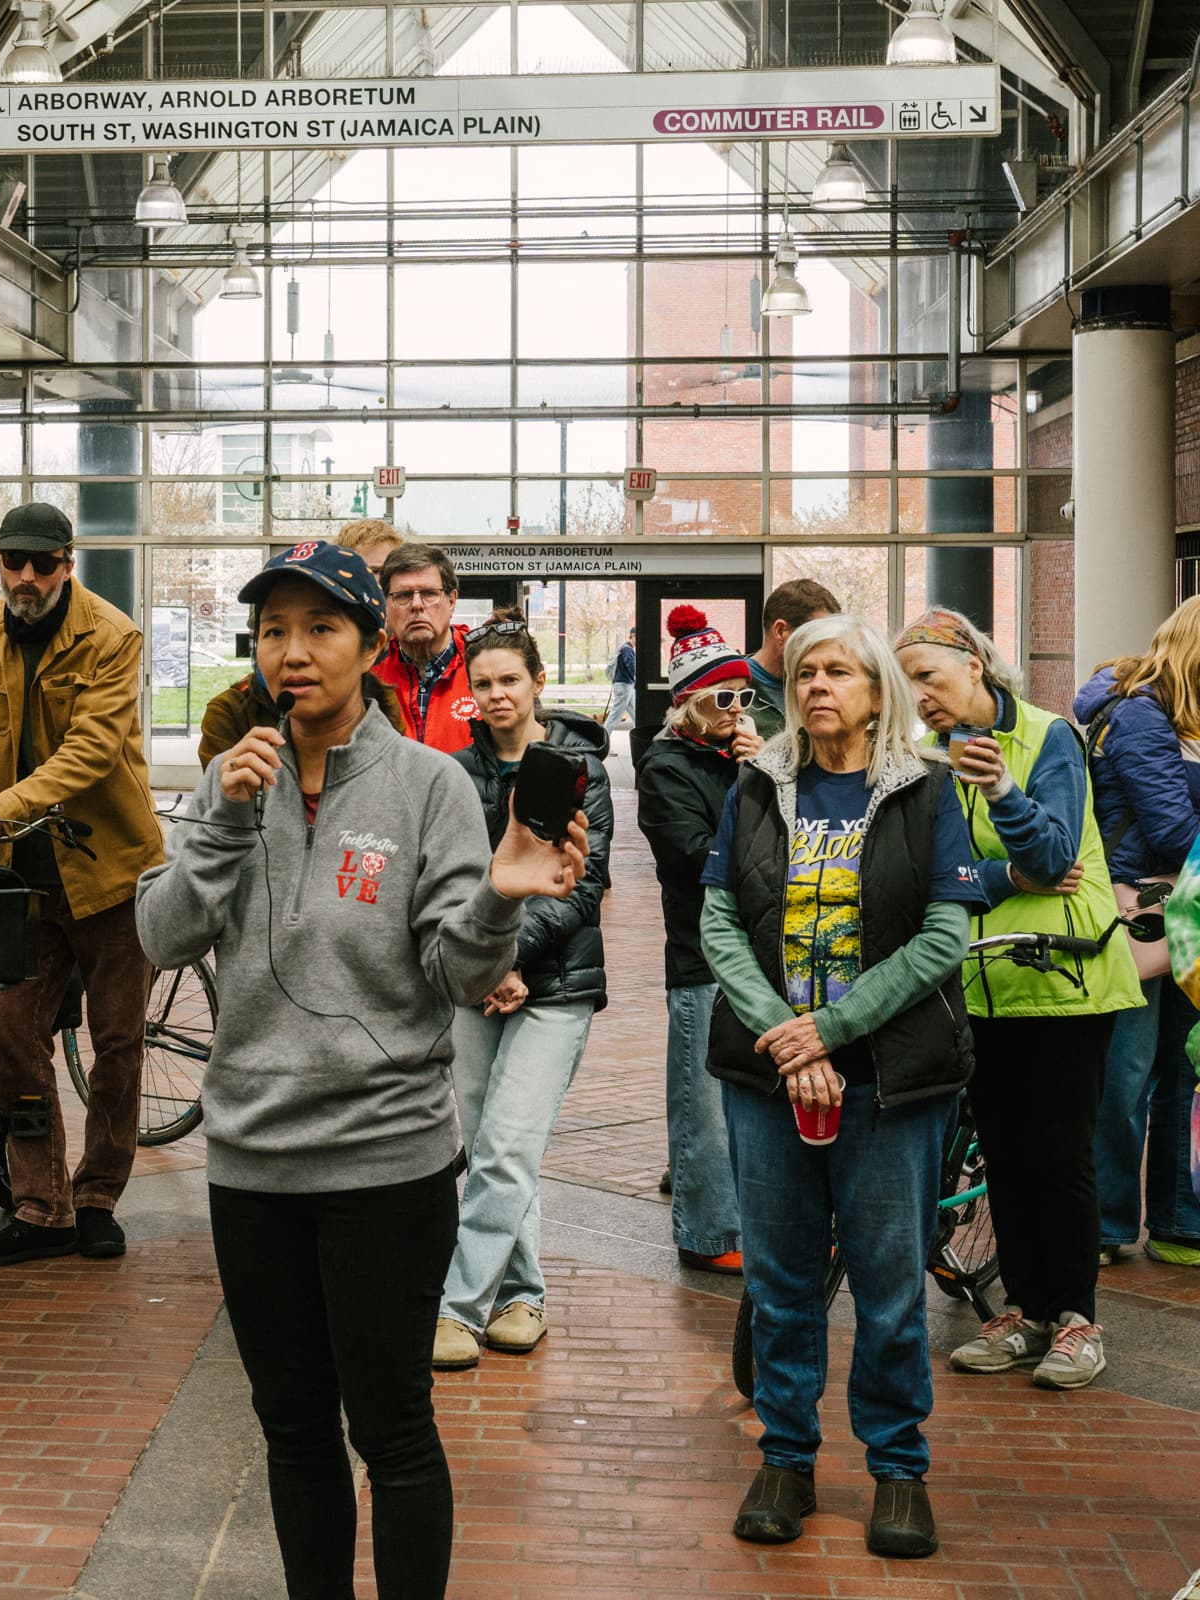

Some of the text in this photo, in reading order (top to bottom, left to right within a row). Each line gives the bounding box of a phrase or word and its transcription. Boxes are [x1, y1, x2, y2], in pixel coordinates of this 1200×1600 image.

[17, 87, 415, 112] ARBORWAY, ARNOLD ARBORETUM
[17, 115, 541, 143] SOUTH ST, WASHINGTON ST (JAMAICA PLAIN)
[663, 108, 873, 132] COMMUTER RAIL
[379, 468, 400, 485] EXIT
[630, 471, 651, 489] EXIT
[285, 541, 318, 562] B
[442, 547, 613, 557] ORWAY, ARNOLD ARBORETUM
[454, 561, 642, 572] ASHINGTON ST (JAMAICA PLAIN)
[793, 817, 867, 835] OVE YO
[788, 831, 863, 867] BLOC
